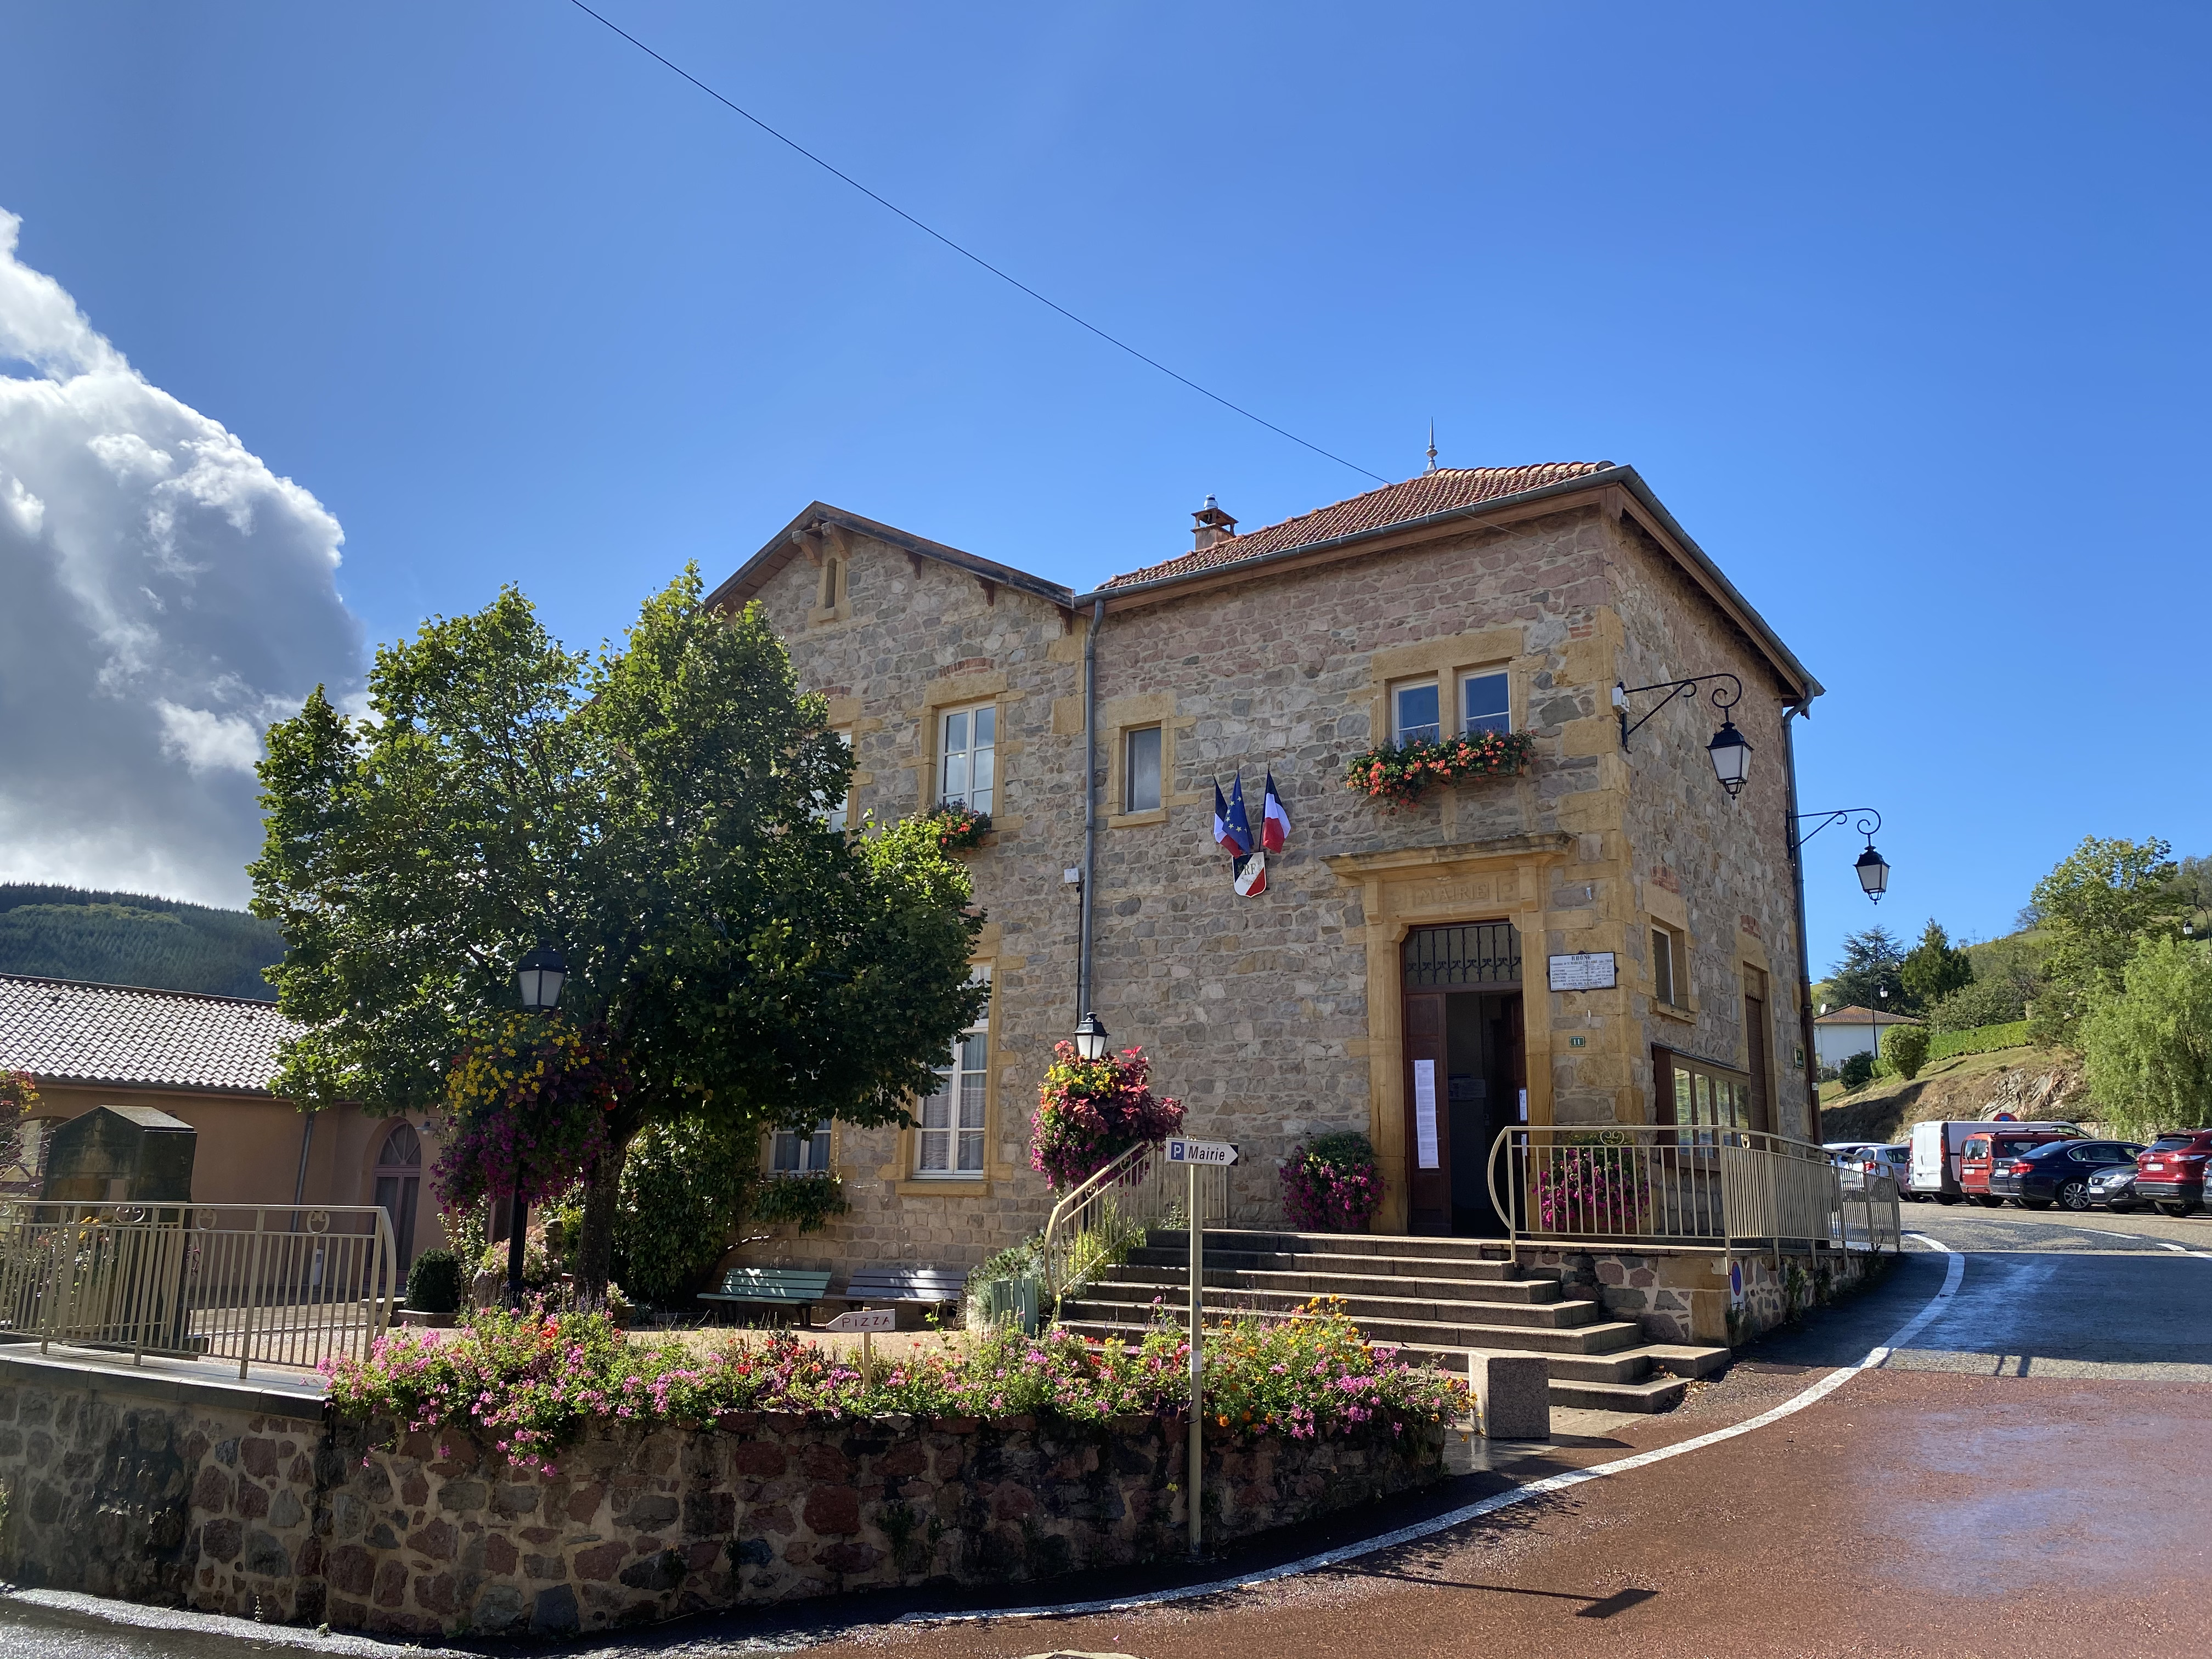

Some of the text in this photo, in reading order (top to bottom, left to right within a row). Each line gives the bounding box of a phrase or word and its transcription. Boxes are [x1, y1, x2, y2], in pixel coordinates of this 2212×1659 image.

[1243, 863, 1256, 876] RF
[1418, 884, 1487, 904] MAIRIE
[1173, 1144, 1225, 1161] P Mairie
